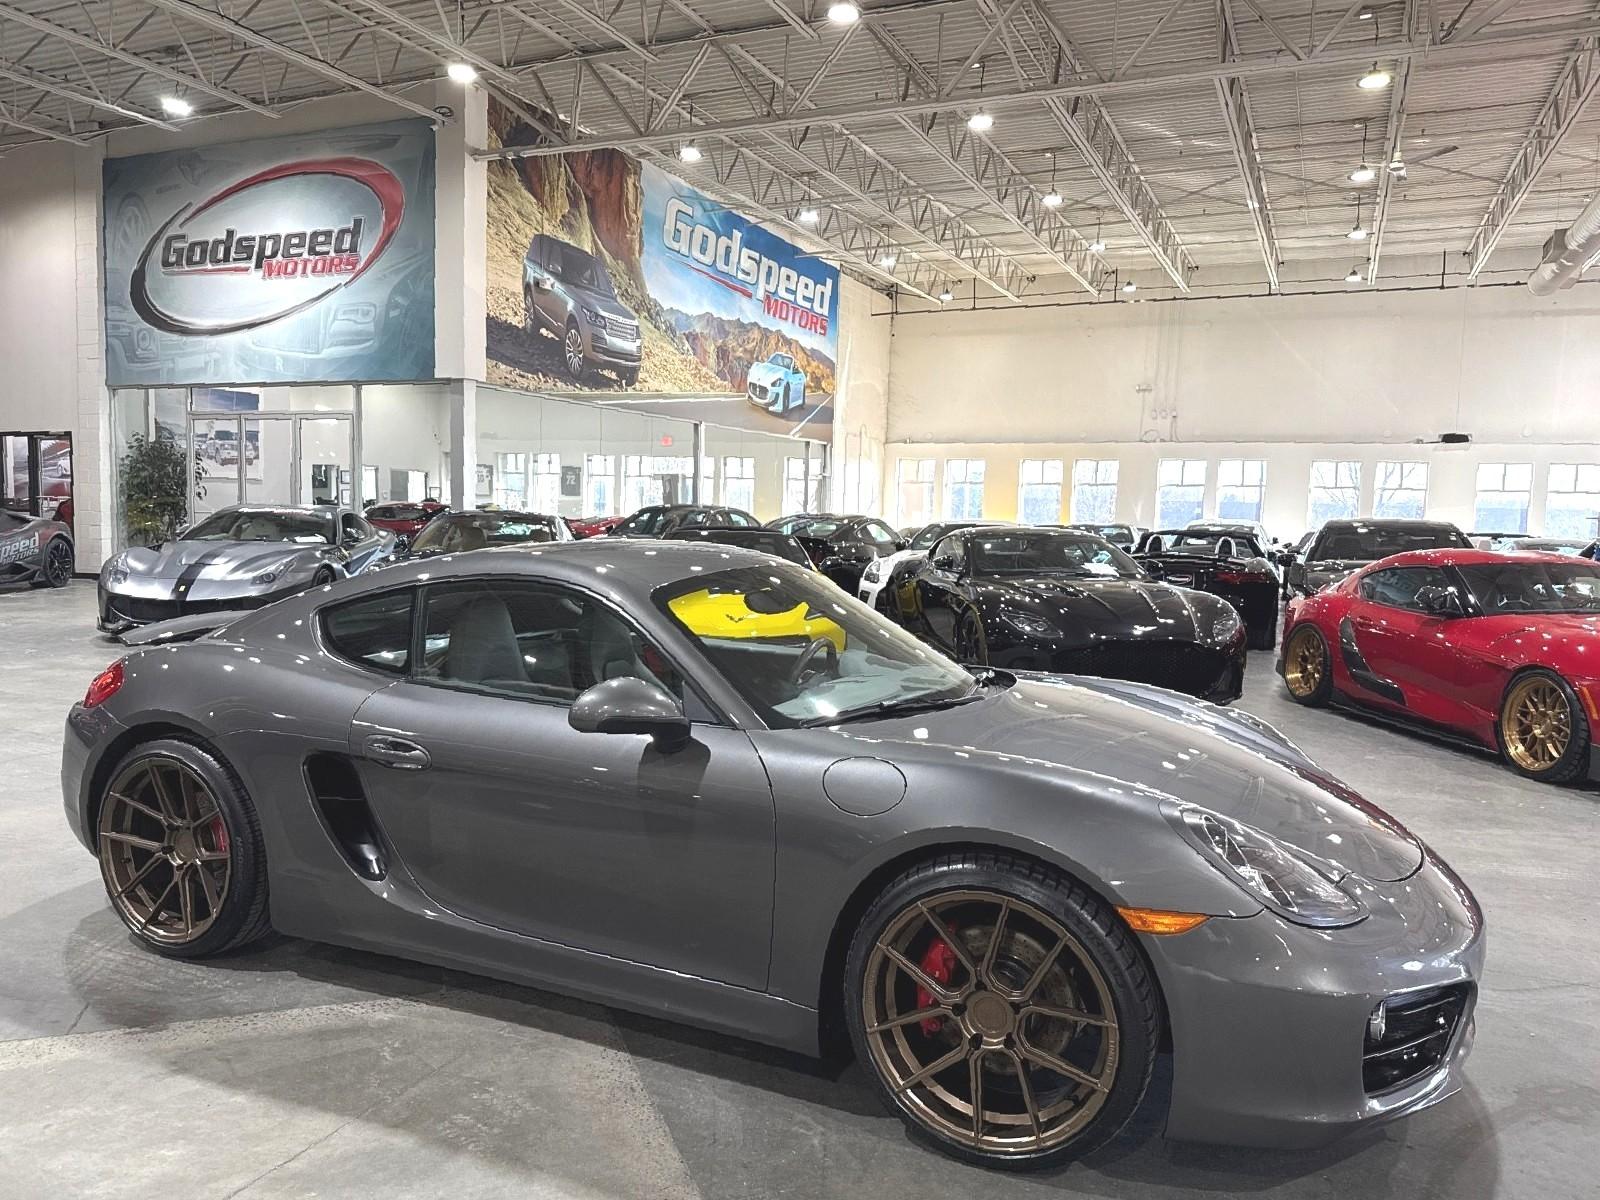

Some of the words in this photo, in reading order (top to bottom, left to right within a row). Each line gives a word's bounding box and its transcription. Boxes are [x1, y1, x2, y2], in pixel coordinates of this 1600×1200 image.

[161, 215, 365, 270] Godspeed
[661, 196, 834, 317] Godspeed
[261, 253, 361, 279] MOTORS
[763, 293, 829, 337] MOTORS
[0, 531, 40, 563] peed
